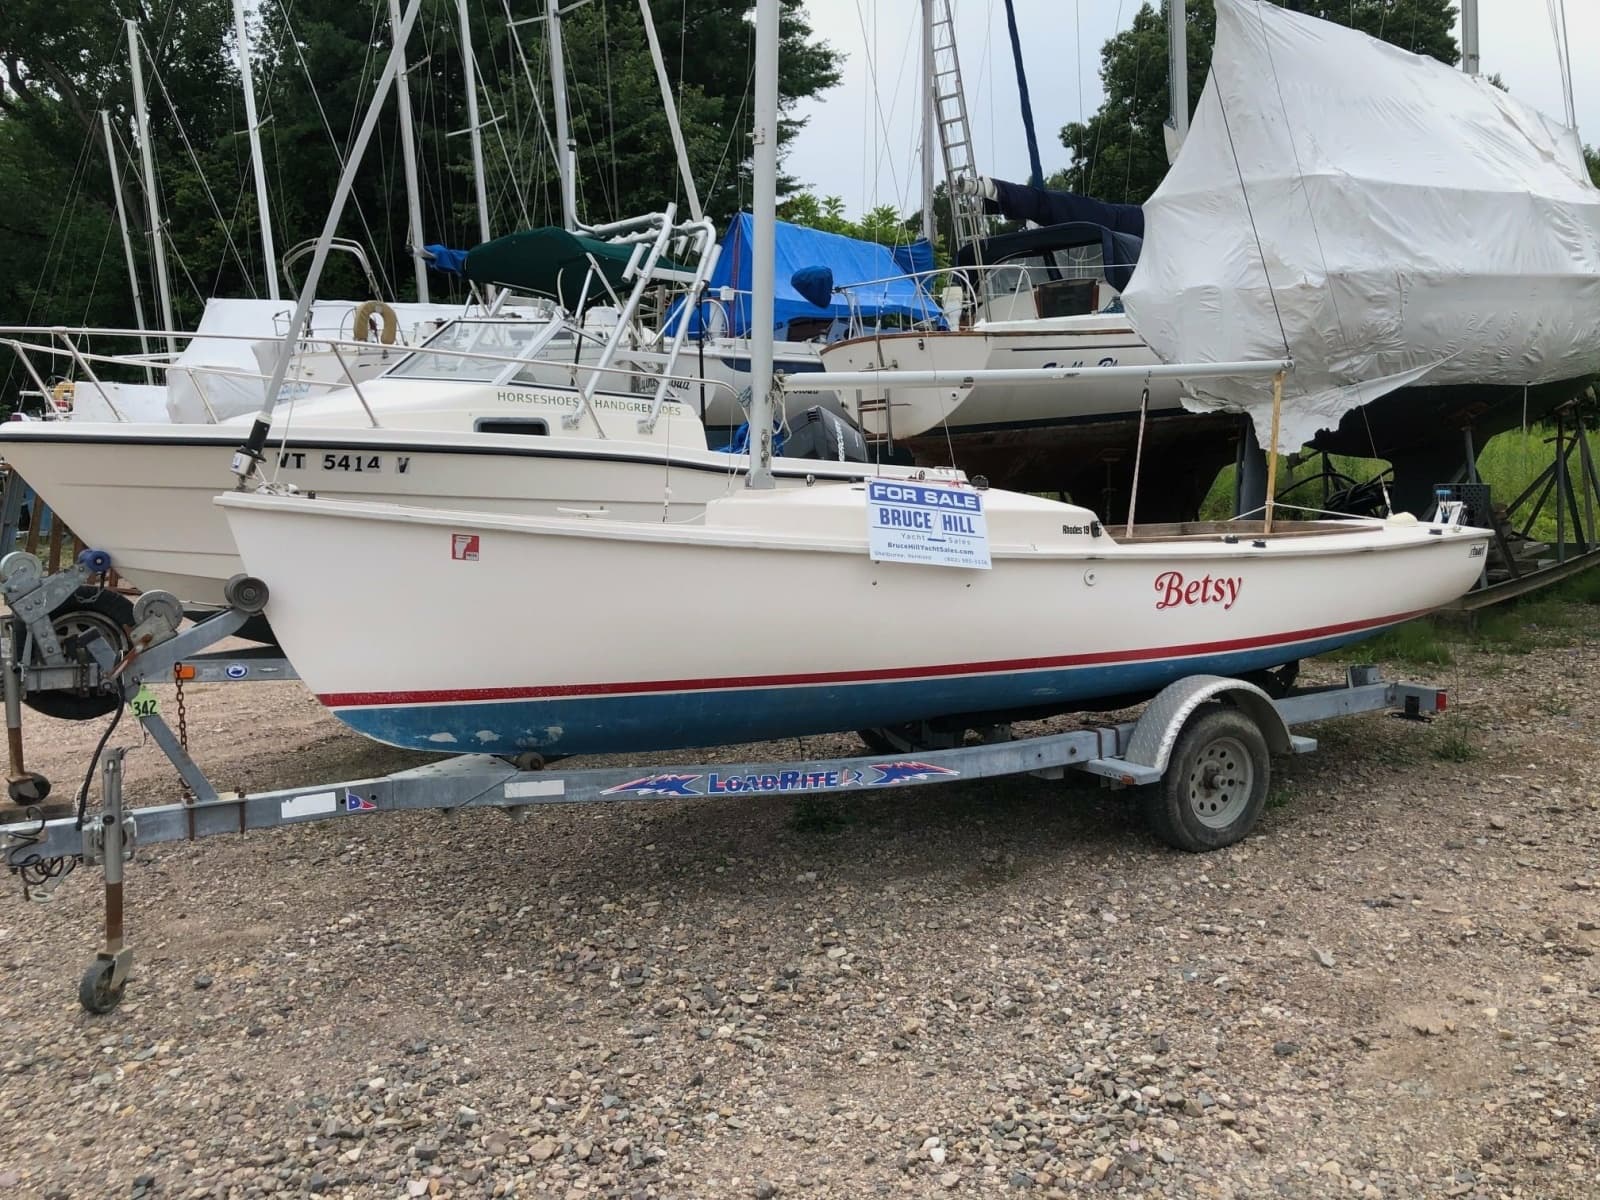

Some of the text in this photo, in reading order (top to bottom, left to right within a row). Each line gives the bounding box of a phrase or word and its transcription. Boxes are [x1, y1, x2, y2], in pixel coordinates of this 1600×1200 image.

[497, 391, 681, 416] HORSESHOES HANDGRENDES
[277, 452, 411, 474] VT 5414 V
[873, 485, 977, 509] FOR SALE
[880, 507, 975, 534] BRUCE HILL
[887, 542, 974, 555] BruceHillYachtSales.com
[901, 532, 971, 545] Yacht Sales
[1154, 570, 1242, 610] Betsy
[133, 699, 158, 716] 342
